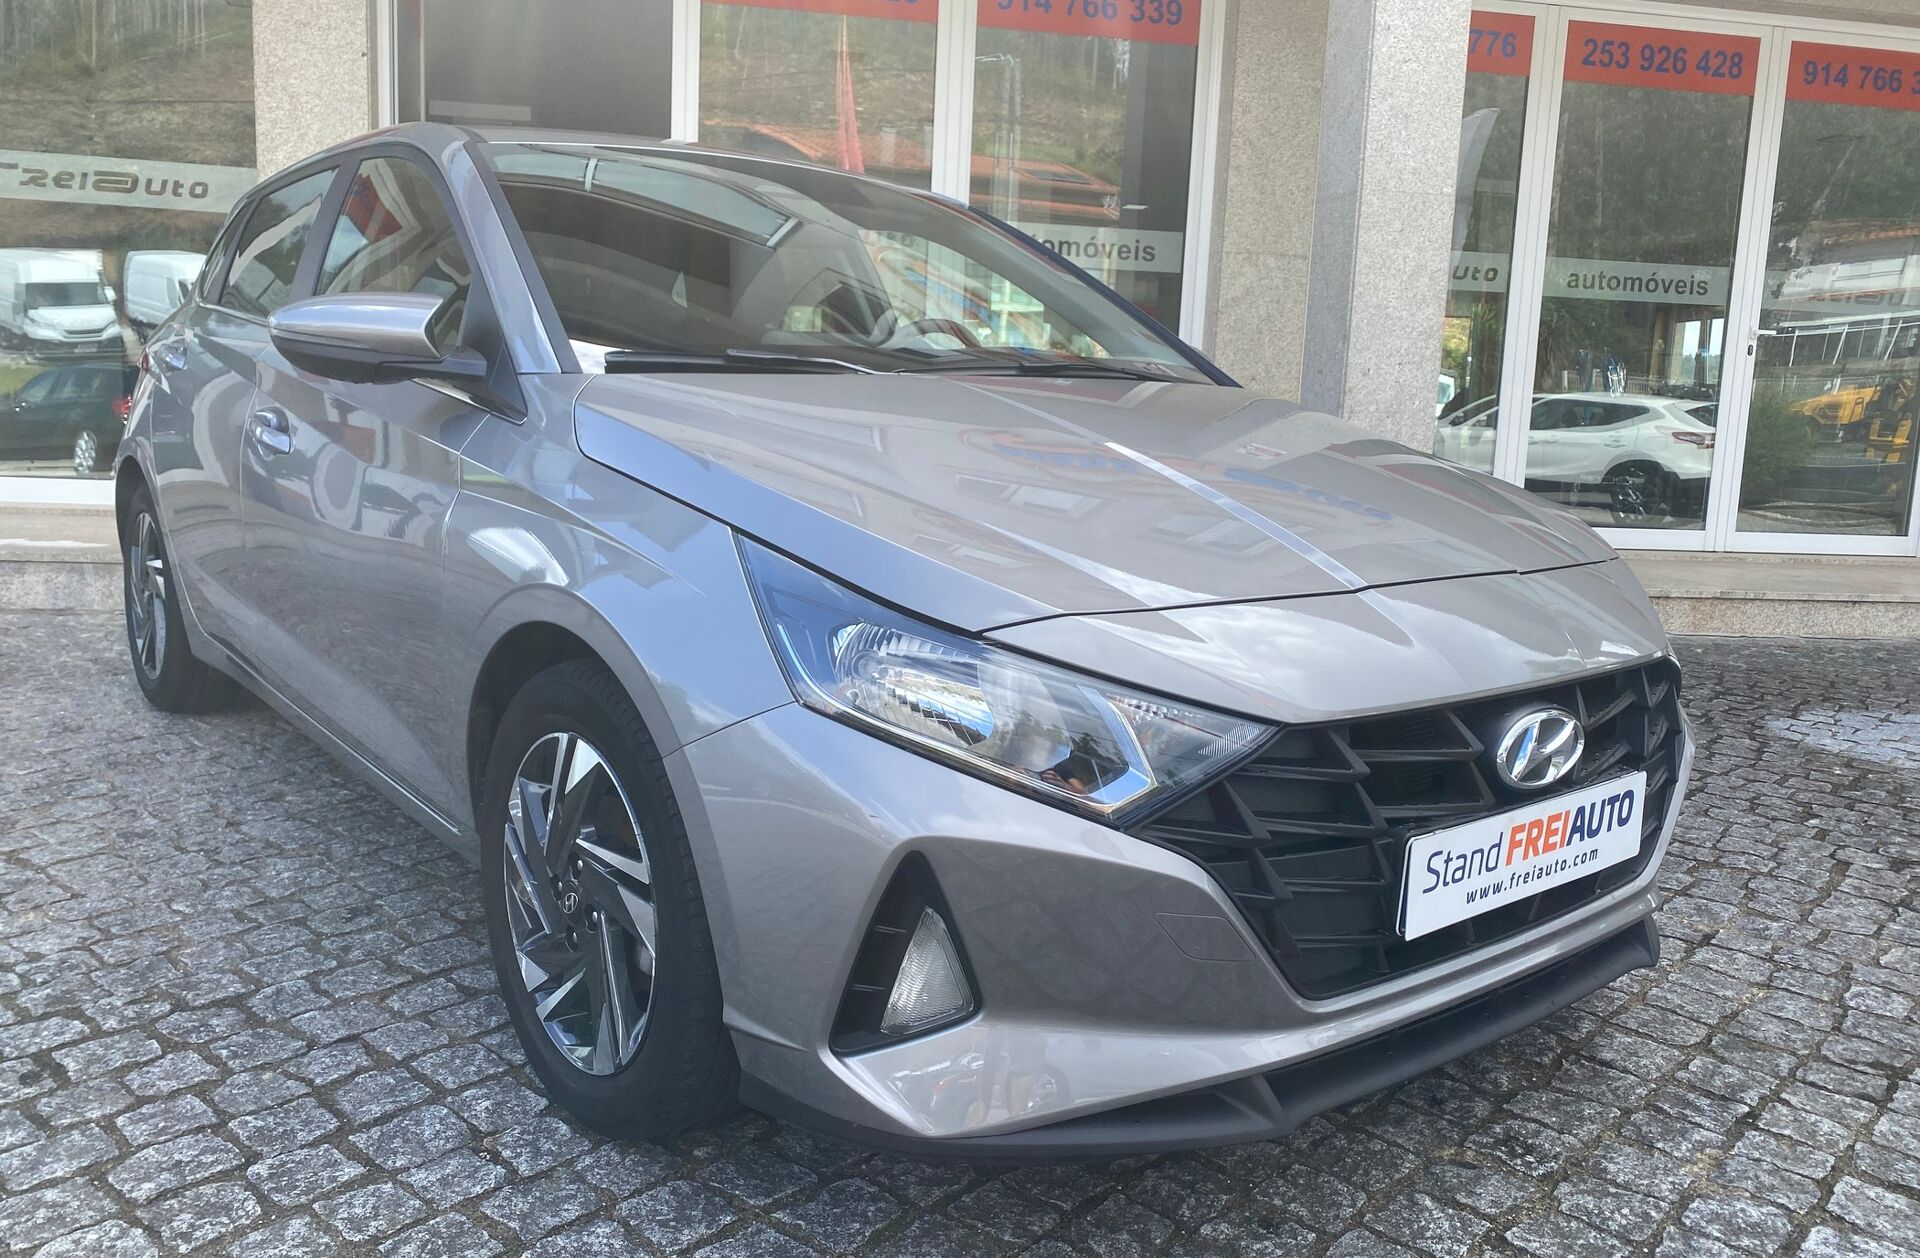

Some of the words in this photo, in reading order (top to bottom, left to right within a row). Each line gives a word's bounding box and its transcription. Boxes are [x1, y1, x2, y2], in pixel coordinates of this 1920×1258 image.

[1130, 0, 1183, 26] 339
[1581, 38, 1630, 69] 253
[1640, 44, 1688, 75] 926
[1696, 49, 1744, 80] 428
[1803, 60, 1849, 88] 914
[1859, 65, 1904, 93] 766
[1567, 271, 1709, 297] automóveis
[1422, 831, 1504, 894] Stand
[1505, 789, 1635, 867] FREIAUTO
[1466, 848, 1599, 904] www.freiauto.com
